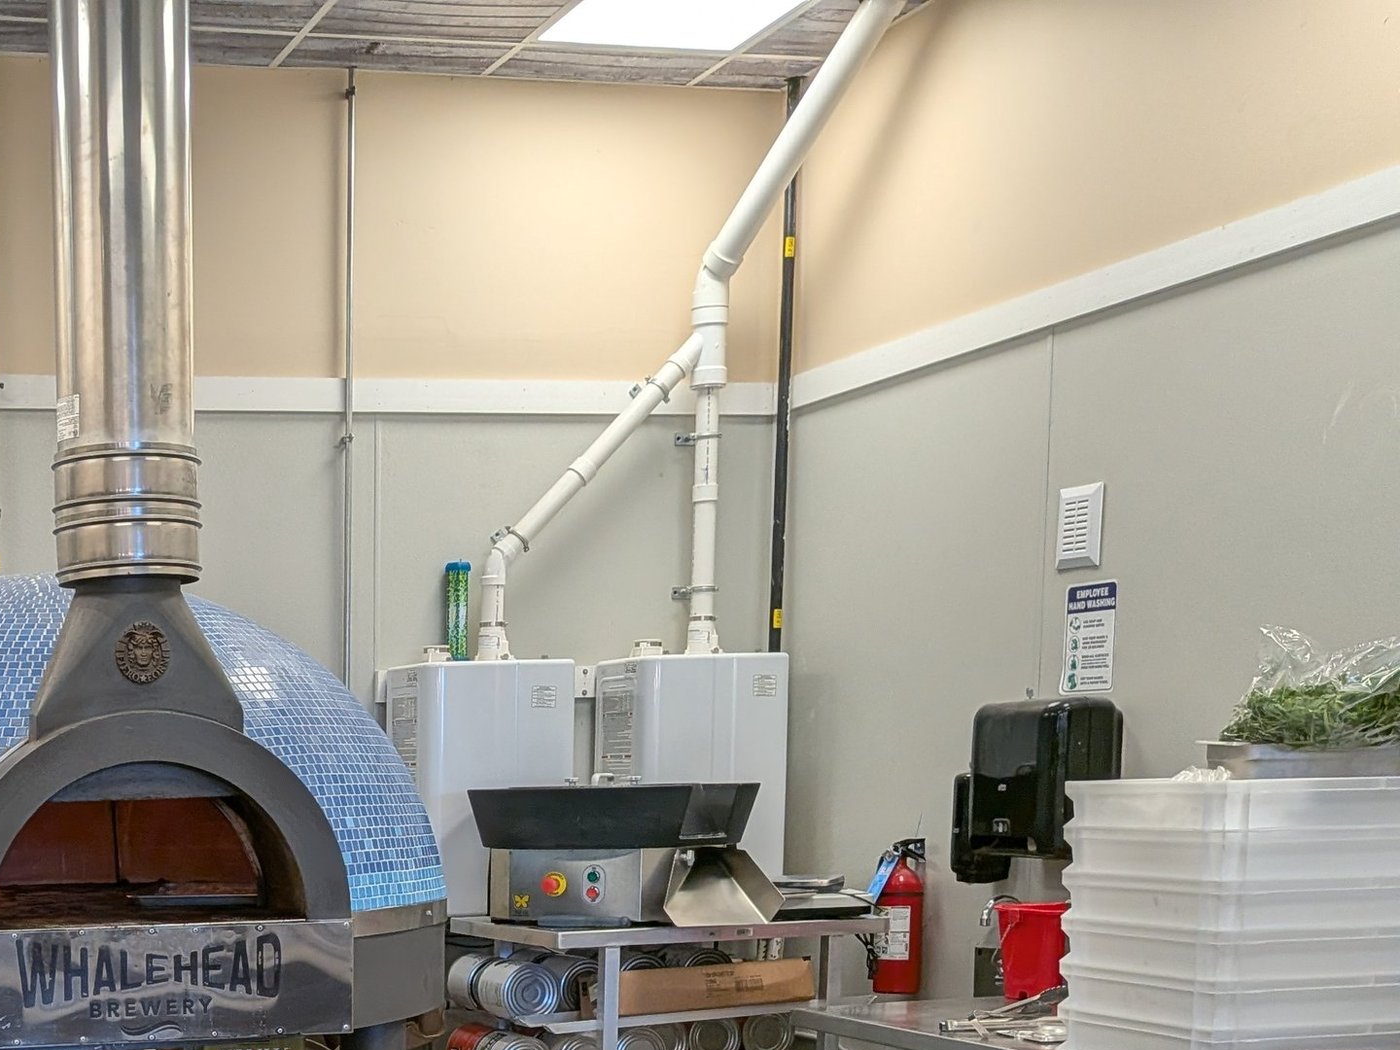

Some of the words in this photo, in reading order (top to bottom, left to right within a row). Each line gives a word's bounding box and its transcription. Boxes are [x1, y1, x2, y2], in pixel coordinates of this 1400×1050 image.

[1076, 586, 1109, 599] EMPLOYEE
[1069, 600, 1086, 610] HAND
[1086, 597, 1115, 608] WASHING
[15, 933, 282, 1008] WHALEHEAD
[89, 997, 213, 1019] BREWERY
